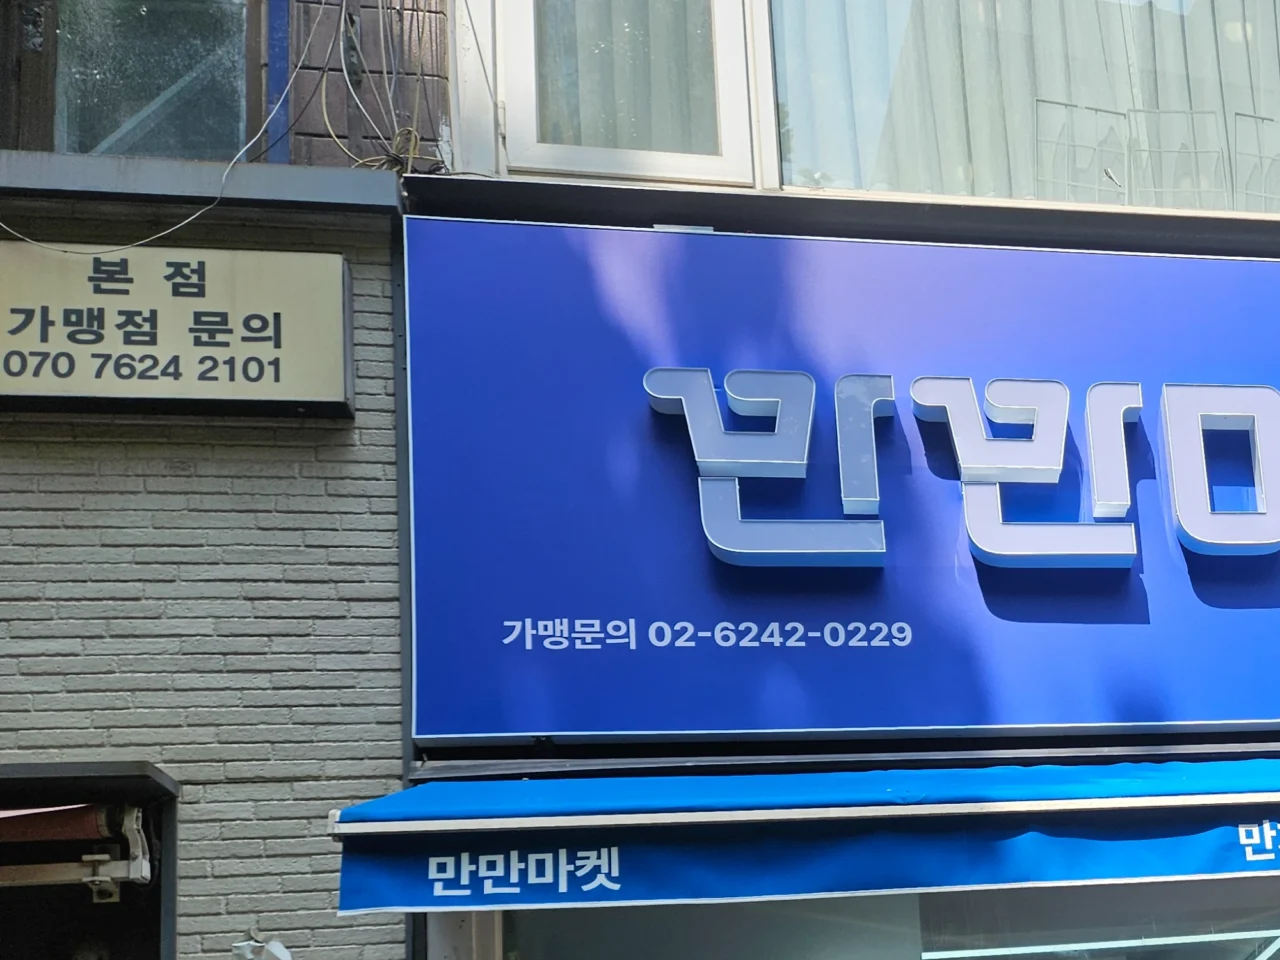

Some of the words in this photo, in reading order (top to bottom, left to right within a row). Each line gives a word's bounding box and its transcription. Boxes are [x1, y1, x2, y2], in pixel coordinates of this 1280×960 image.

[7, 305, 158, 346] 가맹점
[188, 311, 282, 349] 문의
[2, 350, 75, 377] 070
[91, 353, 183, 381] 7624
[197, 356, 281, 383] 2101
[502, 618, 636, 650] 가맹문의
[648, 621, 912, 648] 02-6242-0229
[428, 846, 621, 896] 만만마켓
